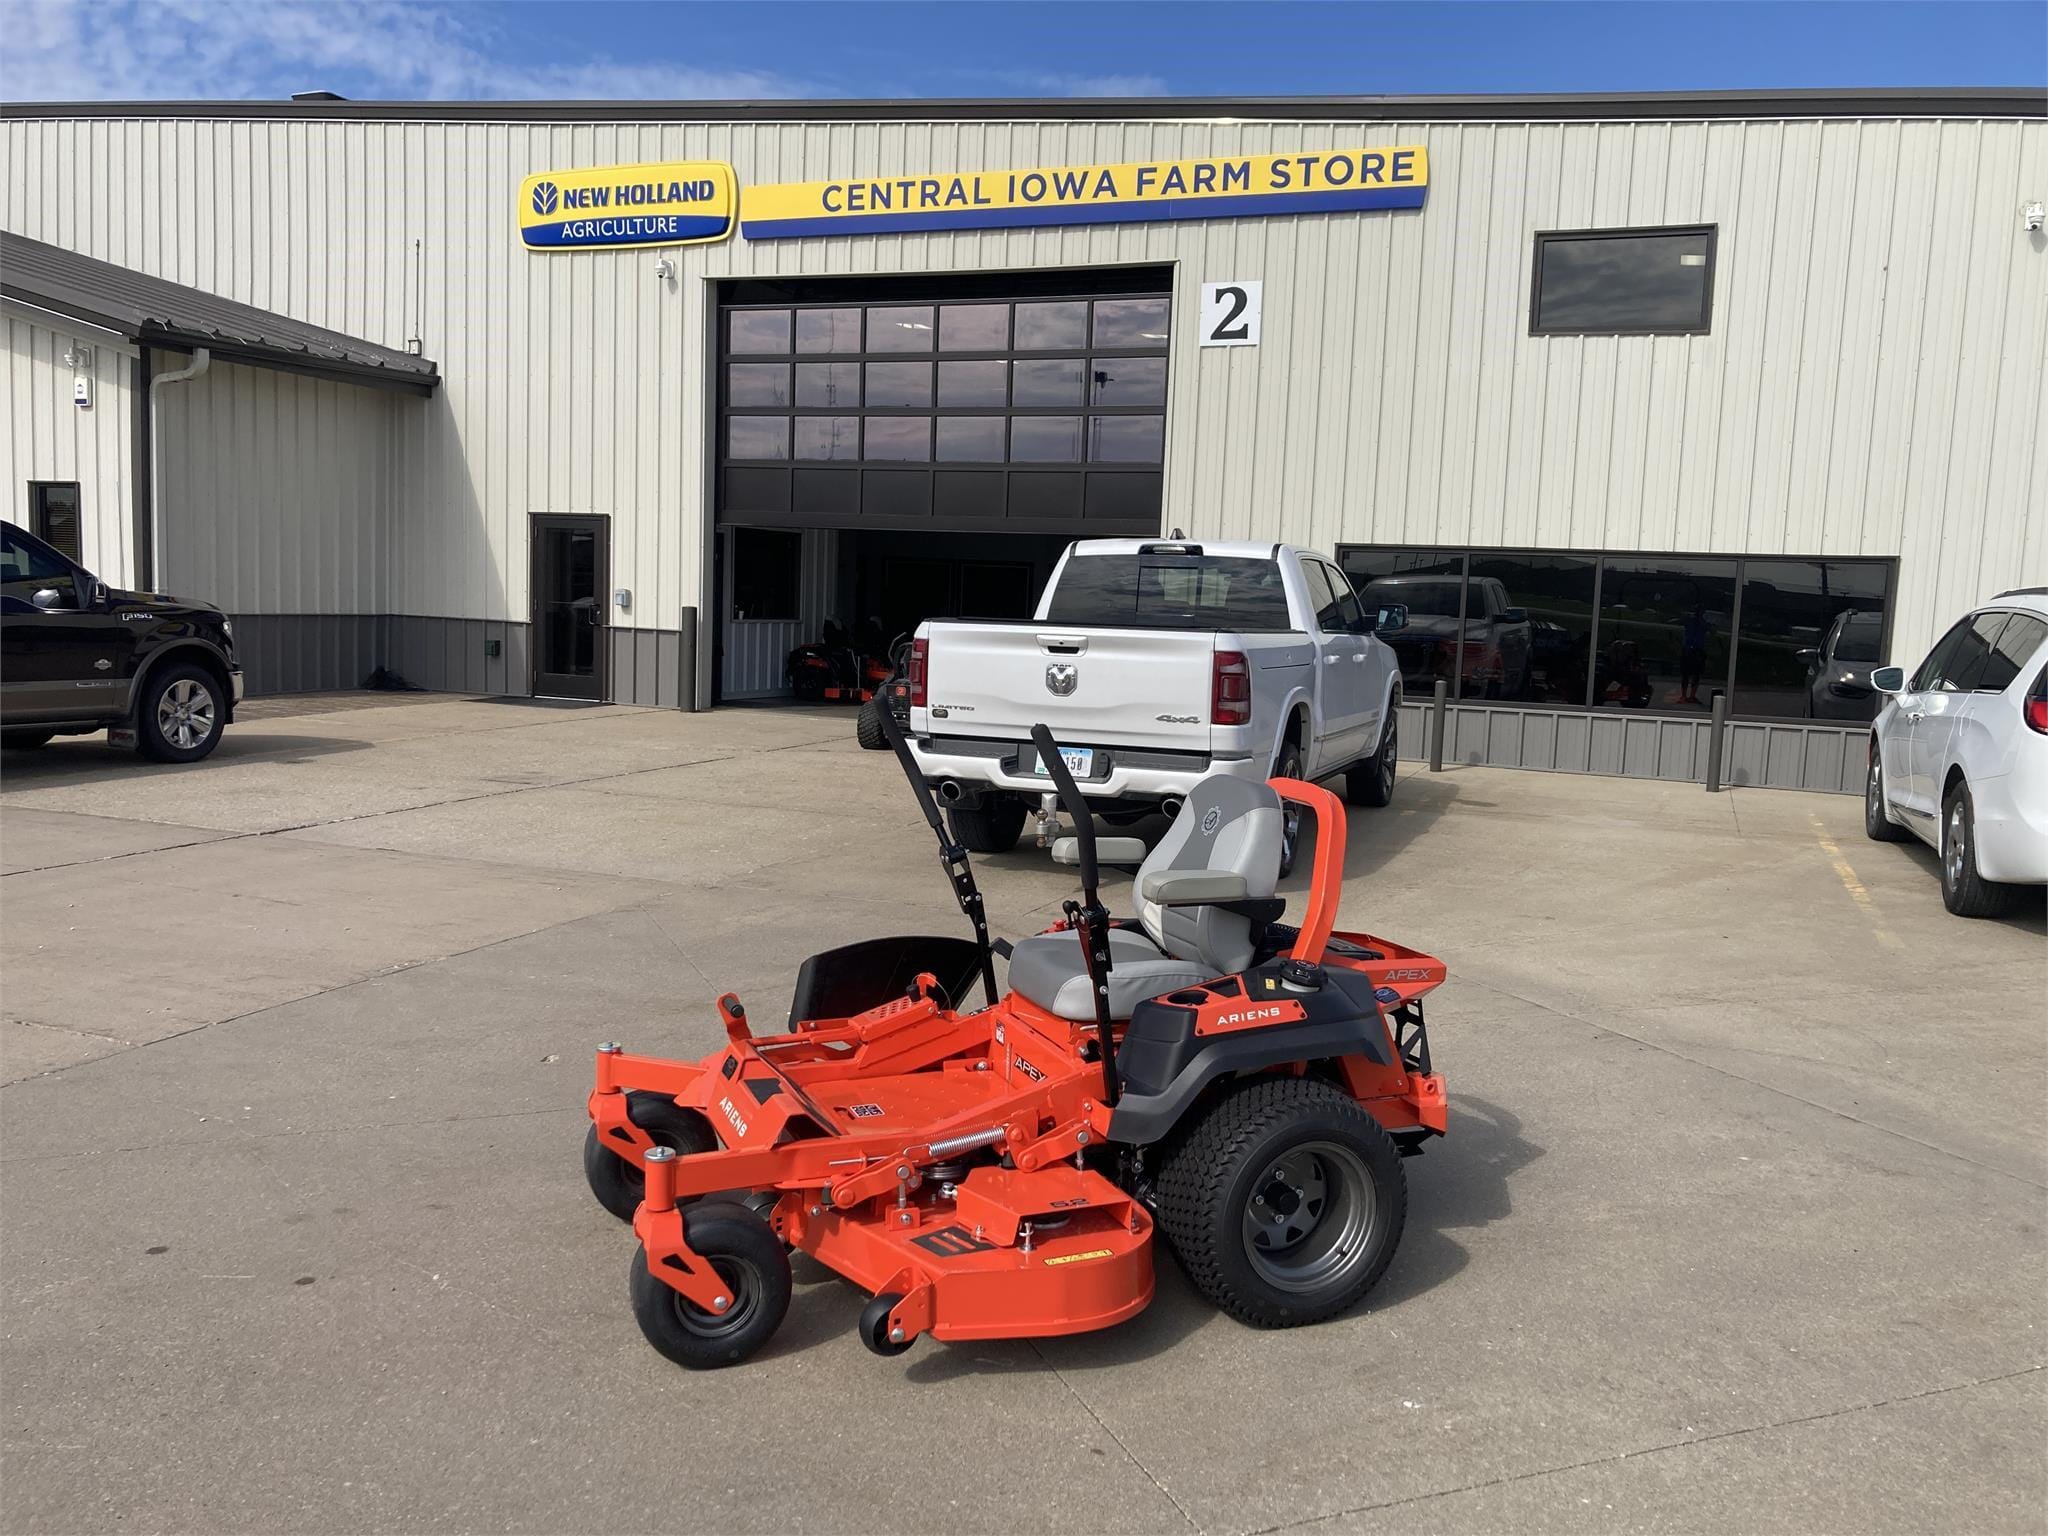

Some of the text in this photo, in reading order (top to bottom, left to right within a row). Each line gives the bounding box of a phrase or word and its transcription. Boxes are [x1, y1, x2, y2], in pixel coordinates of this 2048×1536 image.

[563, 179, 715, 210] NEW HOLLAND
[822, 151, 1415, 211] CENTRAL IOWA FARM STORE
[561, 216, 678, 239] AGRICULTURE
[1210, 286, 1249, 340] 2
[1385, 968, 1432, 981] APEX
[1216, 1007, 1281, 1026] ARIENS
[718, 1096, 748, 1138] ARIENS
